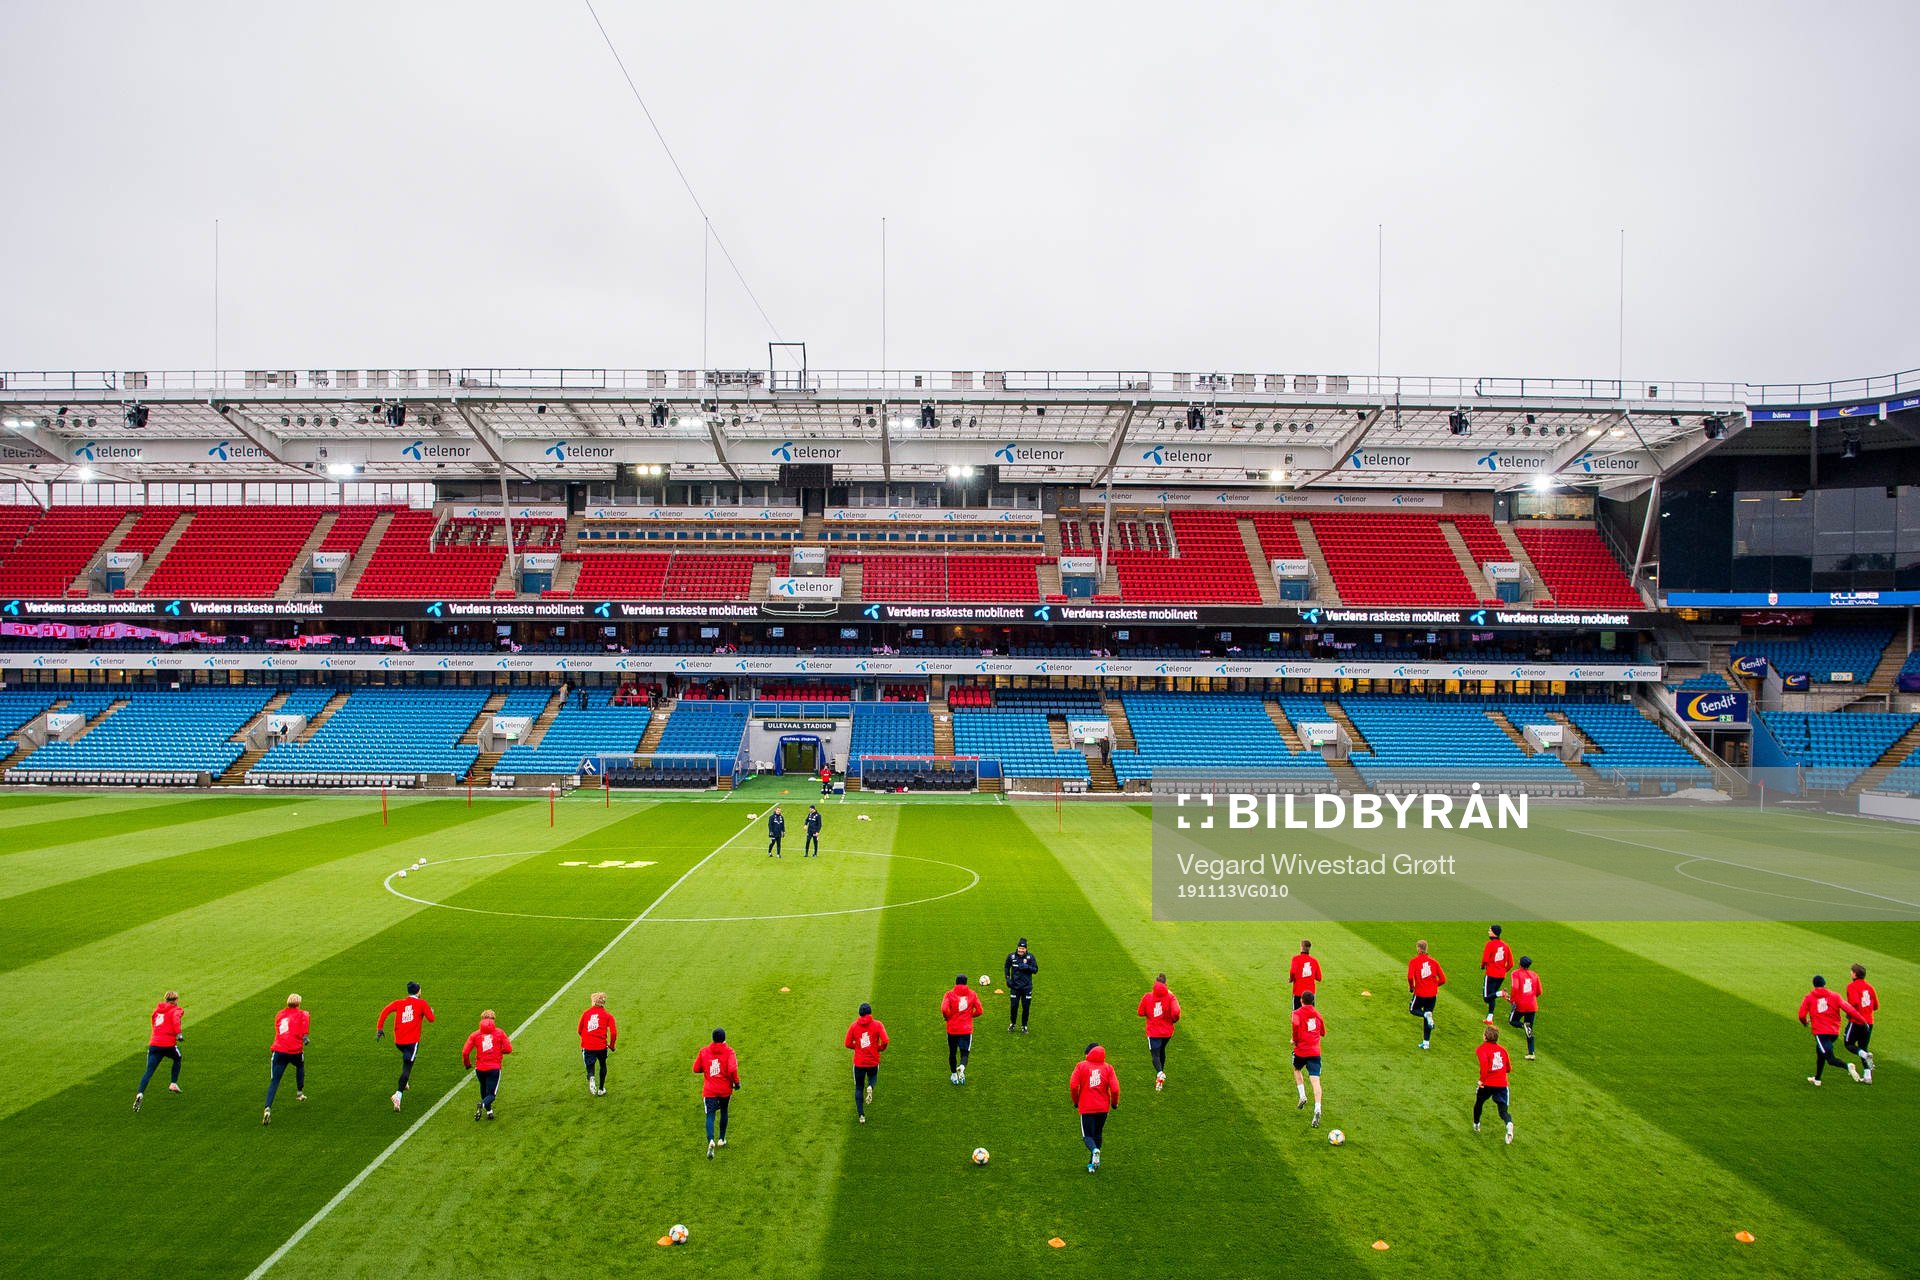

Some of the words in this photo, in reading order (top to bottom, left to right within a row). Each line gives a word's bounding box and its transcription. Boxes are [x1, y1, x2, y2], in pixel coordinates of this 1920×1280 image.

[96, 447, 141, 458] telenor
[424, 446, 470, 457] telenor
[567, 446, 614, 457] telenor
[793, 447, 841, 458] telenor
[1016, 448, 1064, 460] telenor
[1164, 450, 1212, 462] telenor
[1364, 454, 1411, 466] telenor
[1498, 456, 1545, 468] telenor
[1593, 456, 1640, 470] telenor
[795, 581, 833, 593] telenor
[25, 602, 65, 614] Verdens
[67, 602, 106, 614] raskeste
[108, 602, 155, 614] mobilnett
[190, 603, 232, 614] Verdens
[233, 603, 274, 614] raskeste
[275, 603, 323, 614] mobilnett
[449, 603, 492, 615] Verdens
[492, 603, 534, 615] raskeste
[536, 603, 584, 615] mobilnett
[621, 605, 664, 616] Verdens
[665, 605, 707, 616] raskeste
[708, 605, 758, 616] mobilnett
[887, 607, 929, 618] Verdens
[930, 607, 973, 618] raskeste
[975, 607, 1024, 618] mobilnett
[1061, 608, 1104, 620] Verdens
[1106, 608, 1147, 620] raskeste
[1149, 608, 1198, 620] mobilnett
[1325, 611, 1368, 622] Verdens
[1369, 611, 1410, 622] raskeste
[1412, 611, 1460, 622] mobilnett
[1496, 613, 1538, 625] Verdens
[1539, 613, 1580, 625] raskeste
[1581, 613, 1629, 625] mobilnett
[43, 657, 68, 665] telenor
[100, 657, 125, 665] telenor
[156, 657, 182, 665] telenor
[214, 657, 240, 665] telenor
[272, 657, 297, 666] telenor
[330, 658, 356, 666] telenor
[389, 658, 415, 667] telenor
[448, 659, 474, 667] telenor
[507, 659, 533, 667] telenor
[567, 660, 592, 668] telenor
[626, 660, 652, 668] telenor
[686, 660, 712, 668] telenor
[746, 661, 772, 669] telenor
[806, 661, 832, 669] telenor
[866, 661, 892, 669] telenor
[1741, 657, 1766, 670] Bendit
[926, 662, 952, 670] telenor
[986, 663, 1012, 671] telenor
[1046, 663, 1072, 671] telenor
[1106, 664, 1132, 672] telenor
[1166, 664, 1192, 673] telenor
[1226, 665, 1251, 673] telenor
[1285, 666, 1311, 674] telenor
[1345, 667, 1370, 675] telenor
[1404, 667, 1429, 675] telenor
[1462, 668, 1488, 676] telenor
[1521, 669, 1546, 677] telenor
[1579, 669, 1604, 677] telenor
[1701, 694, 1737, 714] Bendit
